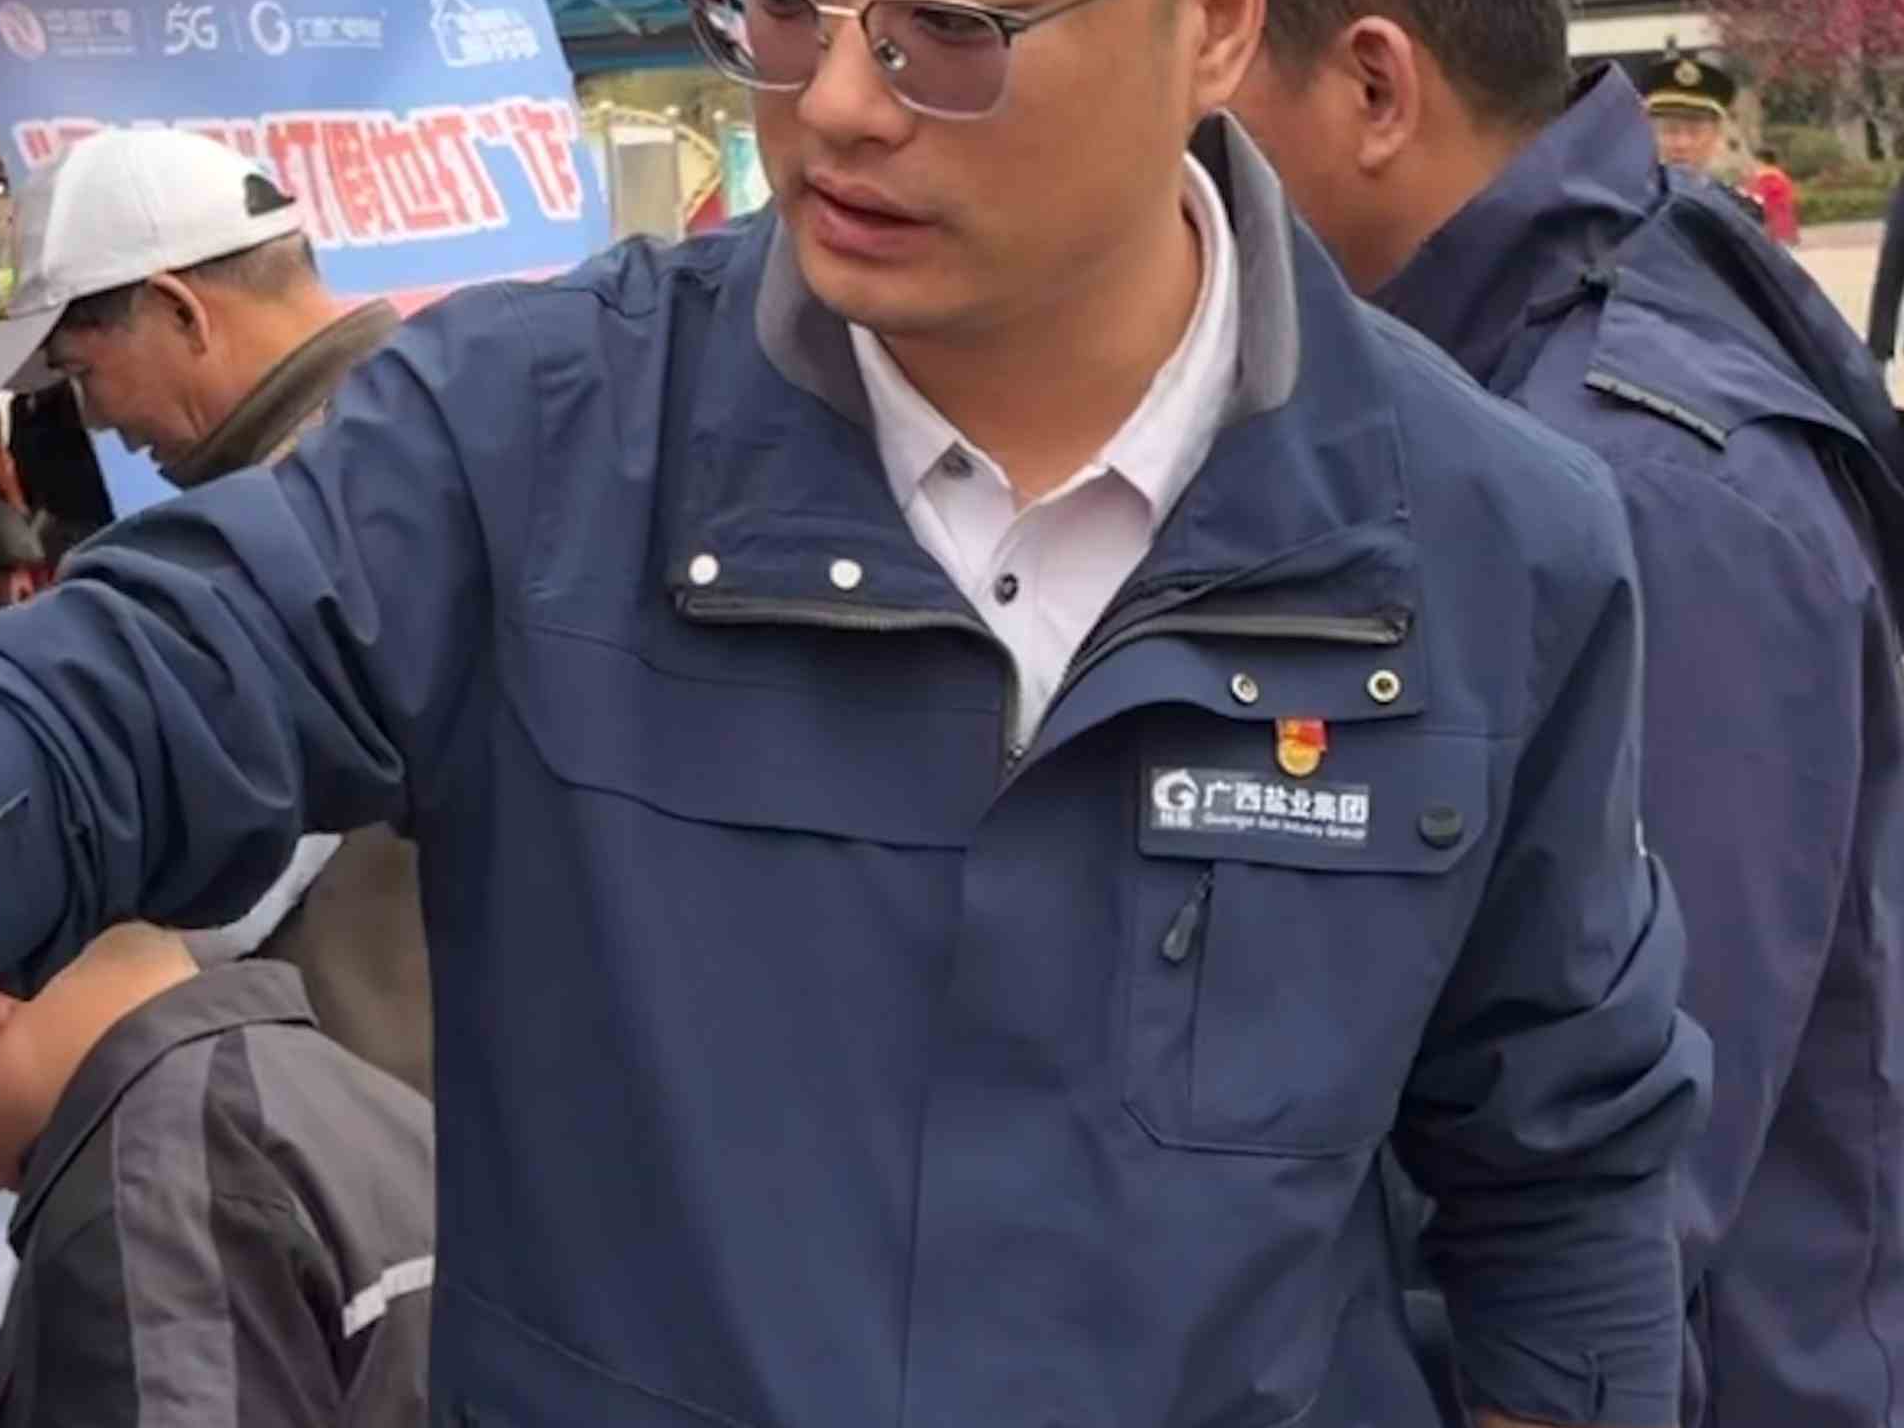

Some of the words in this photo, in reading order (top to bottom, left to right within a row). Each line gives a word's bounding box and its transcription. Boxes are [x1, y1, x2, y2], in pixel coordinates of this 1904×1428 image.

[162, 0, 219, 56] 5G
[1202, 781, 1370, 823] 广西盐业集团
